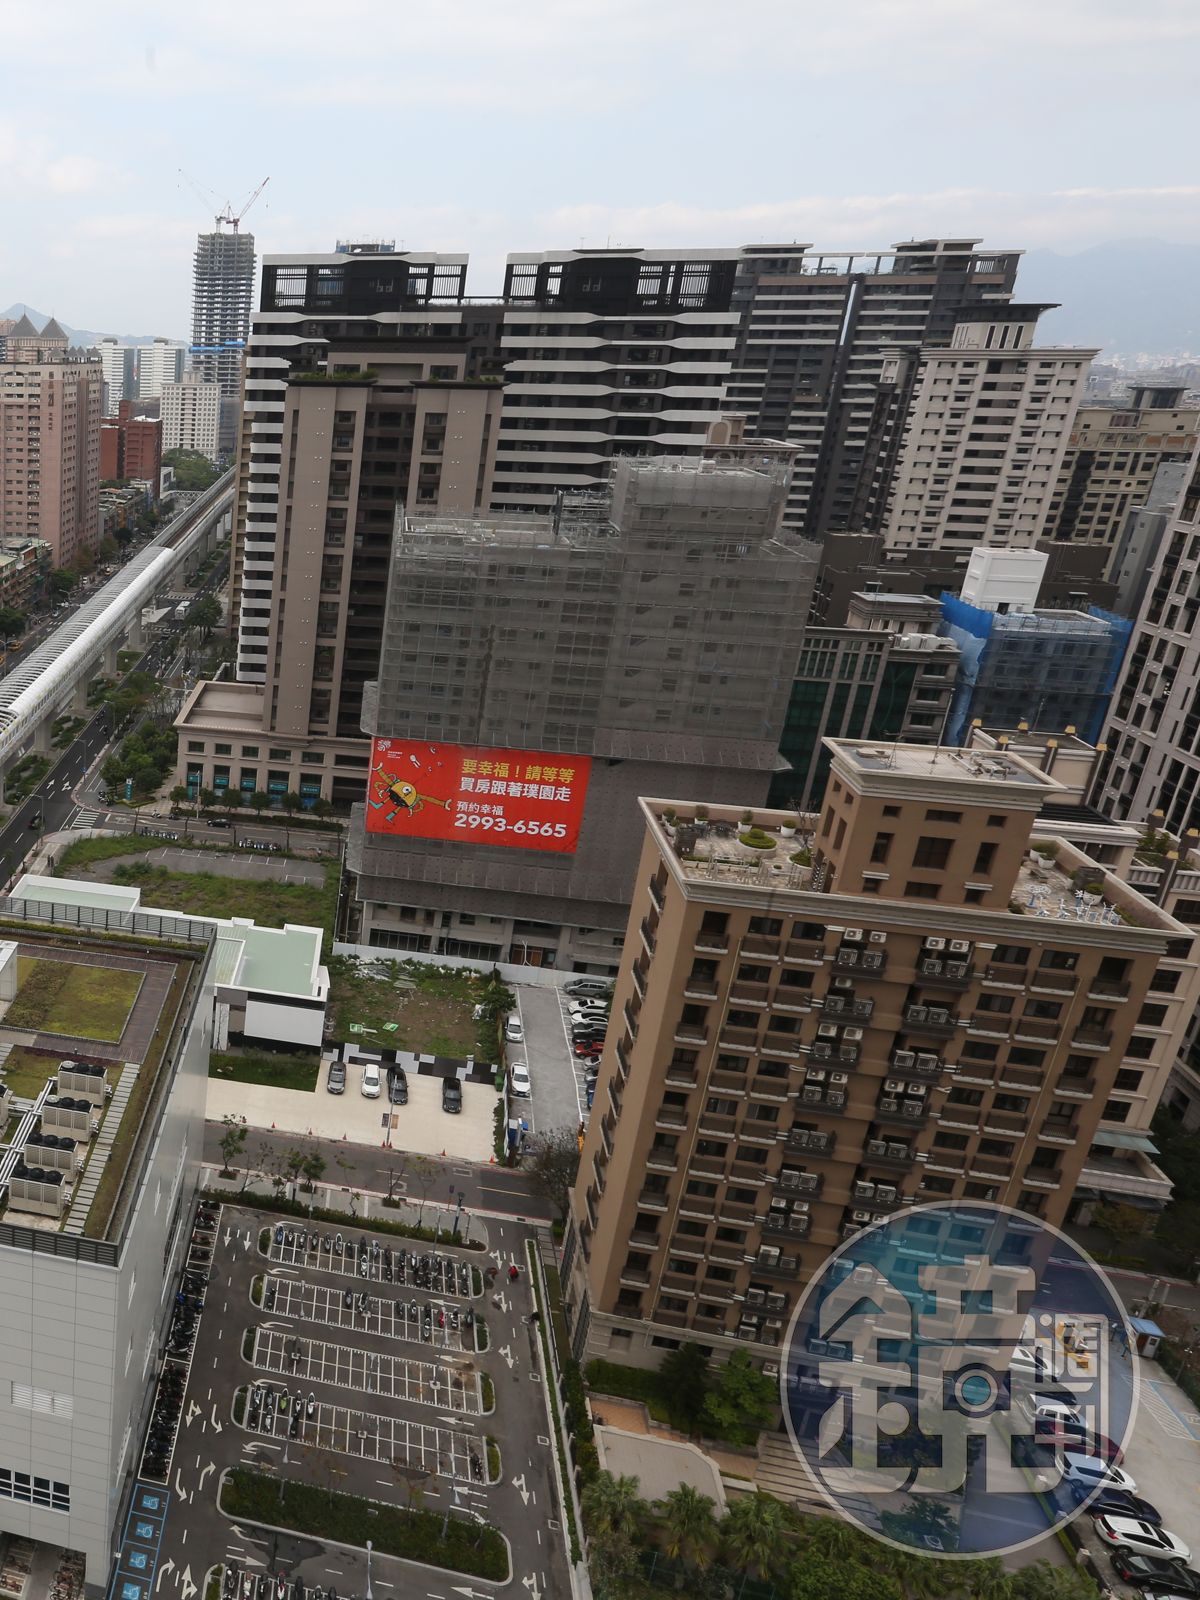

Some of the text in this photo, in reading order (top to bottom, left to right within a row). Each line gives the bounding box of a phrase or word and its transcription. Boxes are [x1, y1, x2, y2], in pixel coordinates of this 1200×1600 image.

[461, 758, 575, 784] 要幸福！請等等
[459, 776, 571, 802] 買房跟著璞園走
[456, 800, 504, 816] 預約幸福
[454, 813, 567, 838] 2993-6565
